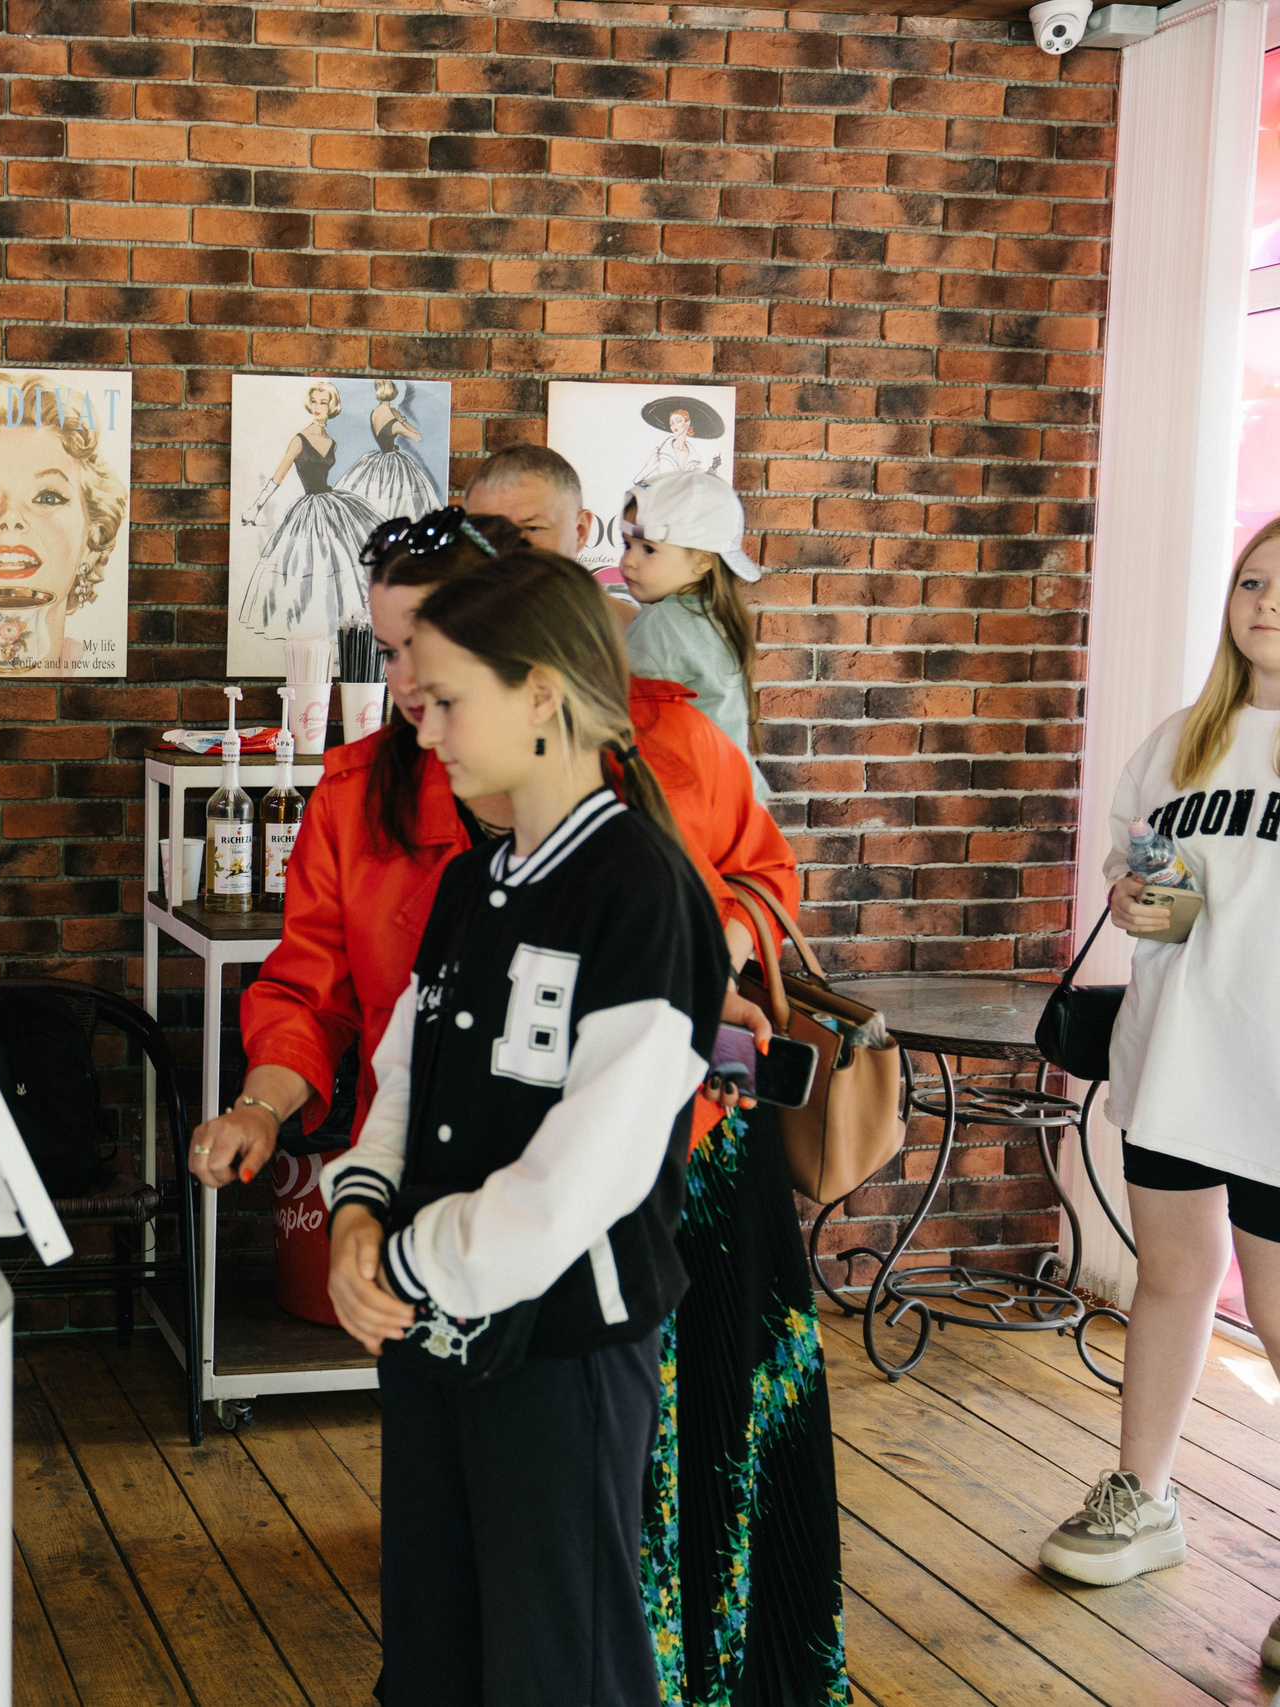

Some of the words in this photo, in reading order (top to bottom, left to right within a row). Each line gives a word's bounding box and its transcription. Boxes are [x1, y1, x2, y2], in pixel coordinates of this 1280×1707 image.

[83, 639, 98, 654] My
[101, 639, 116, 652] life
[12, 656, 42, 669] Coffee
[44, 657, 61, 669] and
[63, 660, 69, 669] a
[71, 660, 90, 669] new
[92, 657, 116, 669] dress
